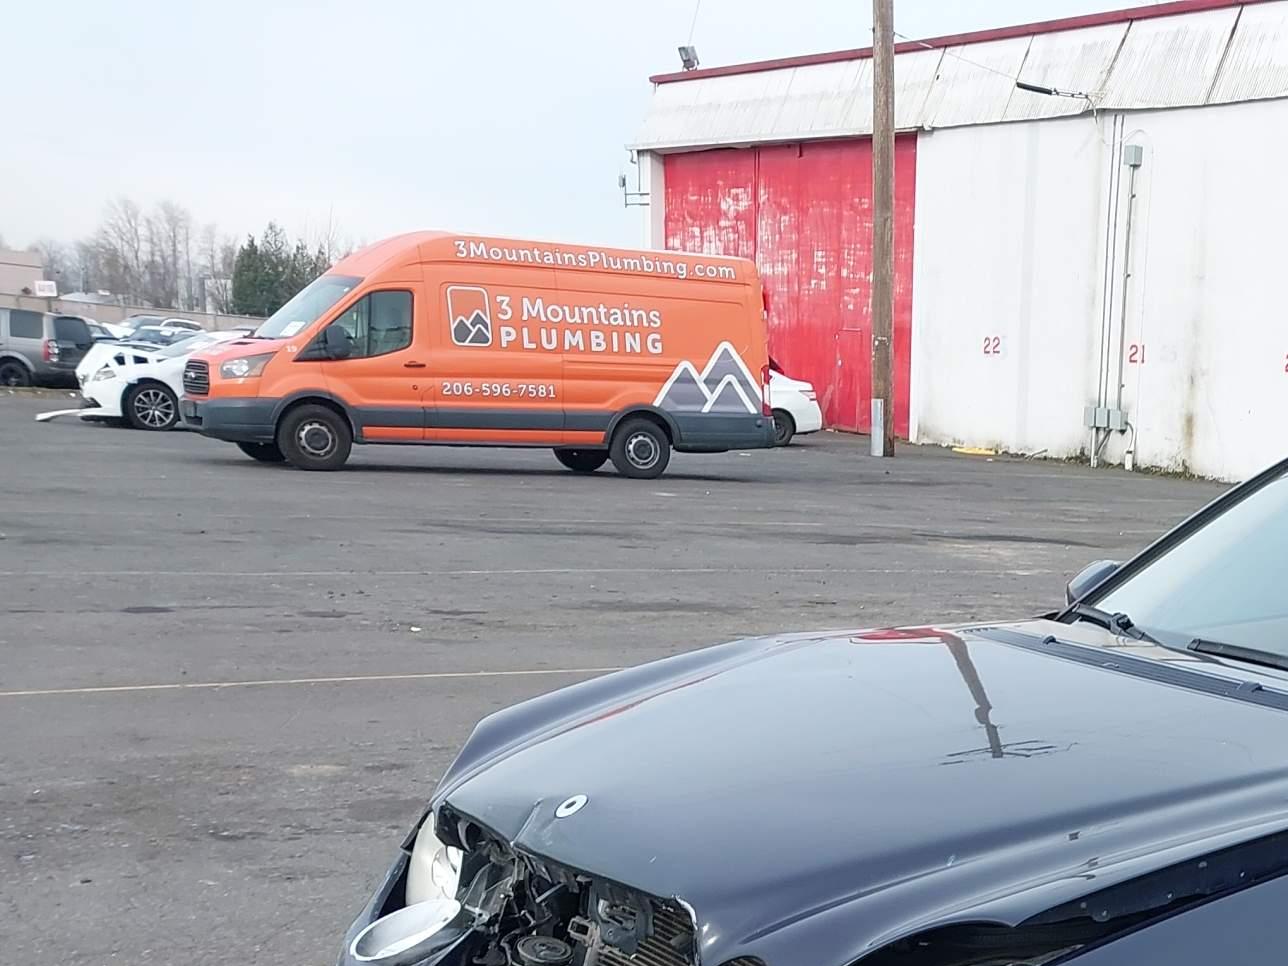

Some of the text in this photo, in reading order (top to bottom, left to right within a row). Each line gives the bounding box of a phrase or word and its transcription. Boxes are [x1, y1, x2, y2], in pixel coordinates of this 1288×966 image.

[454, 240, 737, 280] 3MountainsPlumbing.com
[496, 296, 662, 328] 3 Mountains
[500, 326, 663, 354] PLUMBING
[983, 336, 1001, 355] 22
[1128, 344, 1146, 364] 21
[442, 381, 556, 398] 206-596-7581
